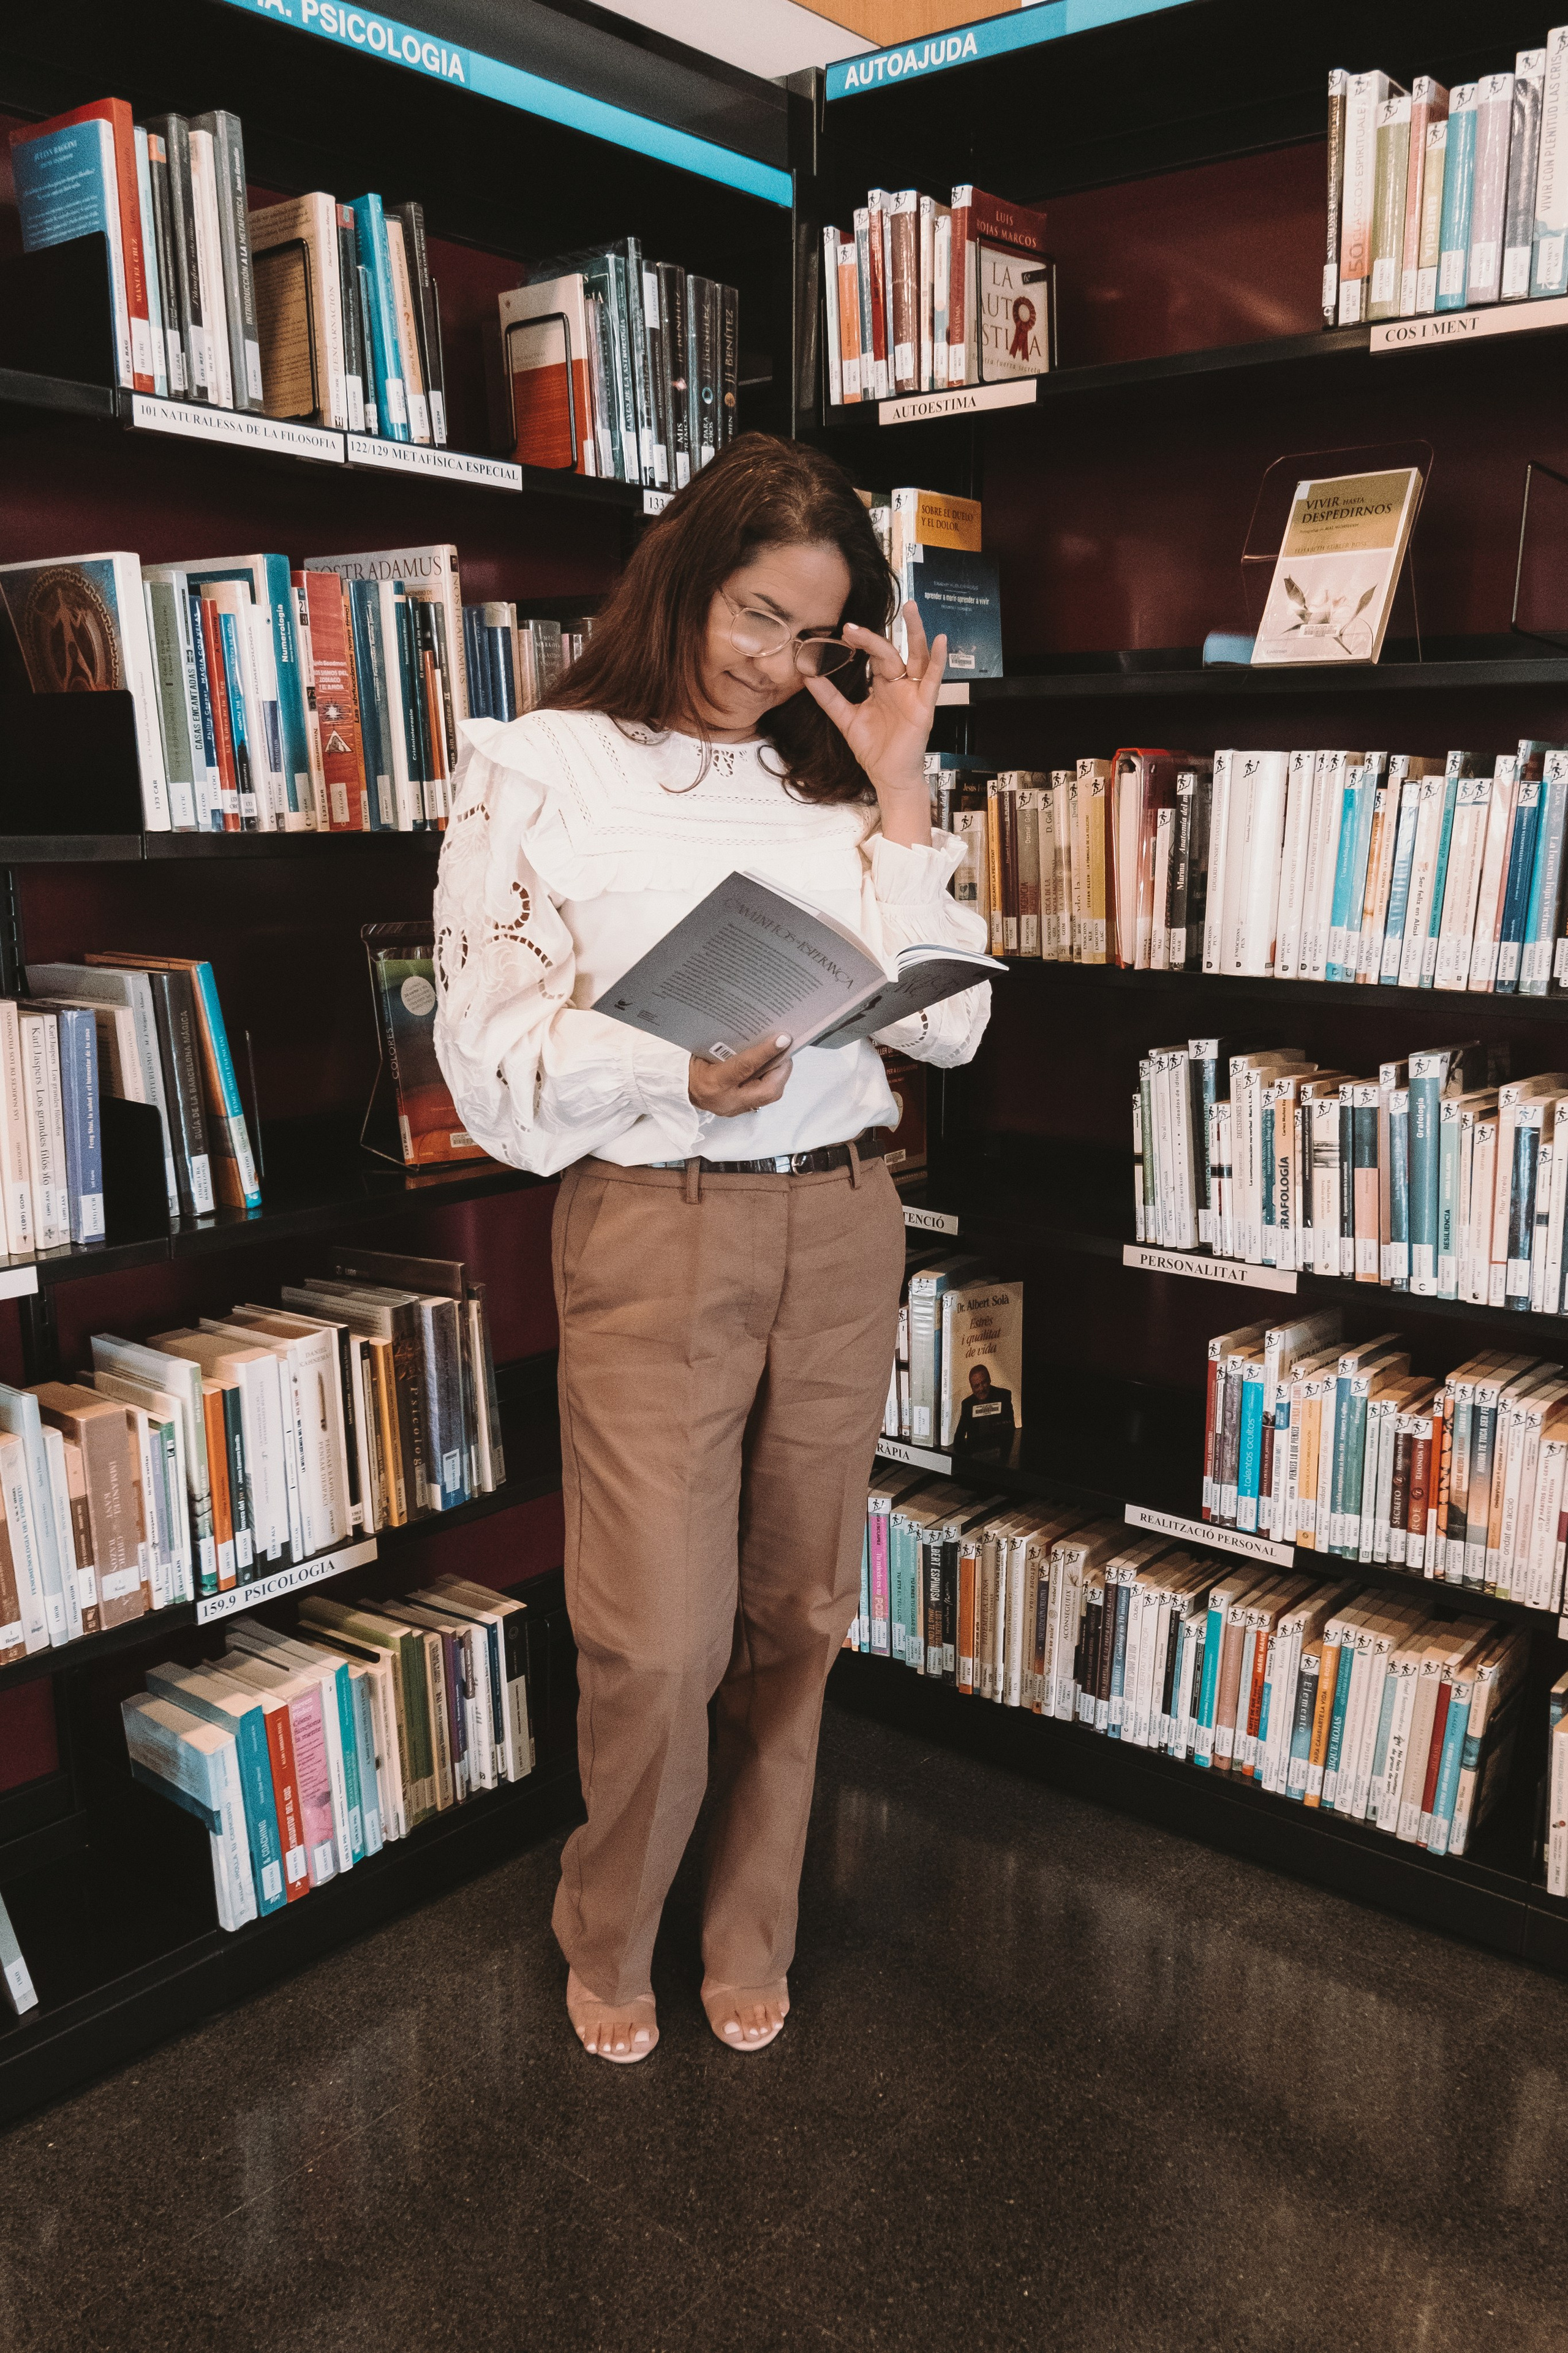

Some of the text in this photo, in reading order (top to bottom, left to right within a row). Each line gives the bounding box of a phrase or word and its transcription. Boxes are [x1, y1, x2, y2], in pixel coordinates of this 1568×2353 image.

[301, 0, 466, 83] PSICOLOGIA
[844, 32, 978, 89] AUTOAJUDA
[1547, 109, 1558, 156] PLENITUD
[233, 147, 243, 175] Grondin
[1546, 158, 1555, 183] CON
[1352, 181, 1364, 243] CLÁSICOS
[1540, 184, 1551, 213] VIVIR
[234, 197, 246, 243] METAFÍSICA
[995, 211, 1014, 227] LUIS
[1425, 195, 1438, 259] ENERGÍA
[241, 244, 249, 255] LA
[1000, 229, 1038, 248] MARCOS
[243, 255, 249, 264] A
[1349, 244, 1363, 273] 50
[992, 261, 1014, 290] LA
[239, 265, 254, 325] INTRODUCCIÓN
[1385, 317, 1479, 342] COS I MENT
[724, 309, 735, 385] JJ BENÍTEZ
[892, 395, 977, 421] AUTOESTIMA
[140, 404, 337, 451] 101 NATURALESSA DE LA FILOSOFIA
[350, 440, 520, 482] 122/129 METAFÍSICA ESPECIAL
[649, 496, 665, 511] 133
[921, 505, 974, 522] SOBRE EL DUELO
[1302, 503, 1393, 524] DESPEDIRNOS
[1305, 496, 1365, 511] VIVIR HASTA
[921, 517, 960, 532] Y EL DOLOR
[194, 613, 202, 638] VELAS
[275, 603, 289, 663] Numerología
[452, 575, 467, 685] NOSTRADAMUS
[198, 662, 206, 684] MAGIA
[247, 625, 259, 695] NUMEROLOGÍA
[349, 654, 358, 707] abducciones
[189, 668, 203, 750] CASAS ENCANTADAS
[1178, 817, 1188, 854] Anatomía
[1177, 862, 1186, 890] Marina
[796, 941, 854, 989] ESPERANÇA
[1500, 945, 1509, 978] EMOCIONS
[6, 1011, 15, 1054] FILÓSOFOS
[31, 1026, 41, 1048] Karl
[31, 1049, 43, 1086] Jaspers
[48, 1043, 57, 1066] Jaspers
[386, 1027, 398, 1079] COLORES
[11, 1070, 17, 1078] DE
[179, 1010, 203, 1139] GUÍA DE LA BARCELONA MÁGICA
[35, 1089, 44, 1108] Los
[51, 1081, 60, 1104] grandes
[34, 1109, 47, 1149] grandes
[1415, 1097, 1425, 1139] Grafología
[1248, 1178, 1253, 1187] La
[1442, 1209, 1451, 1251] RESILIENCIA
[1140, 1253, 1248, 1282] PERSONALITAT
[957, 1294, 1011, 1314] Dr. Albert Solà
[960, 1326, 1001, 1346] i qualitat
[969, 1315, 994, 1330] Estrès
[965, 1342, 998, 1359] de vida
[876, 1441, 911, 1460] RÀPIA
[1243, 1417, 1256, 1488] talentos ocultos
[1415, 1449, 1424, 1481] RHONDA
[1392, 1490, 1402, 1525] SECRETO
[1139, 1513, 1277, 1557] REALITZACIÓ PERSONAL
[23, 1534, 37, 1597] FENOMENOLOGIA
[202, 1559, 336, 1618] 159.9 PSICOLOGIA
[930, 1569, 940, 1602] ESPINOSA
[1063, 1590, 1072, 1641] ACONSEGUEIX
[1116, 1633, 1125, 1660] Coaching
[1299, 1678, 1311, 1734] Elemento
[1331, 1716, 1343, 1743] ROJAS
[258, 1819, 271, 1856] COACHING
